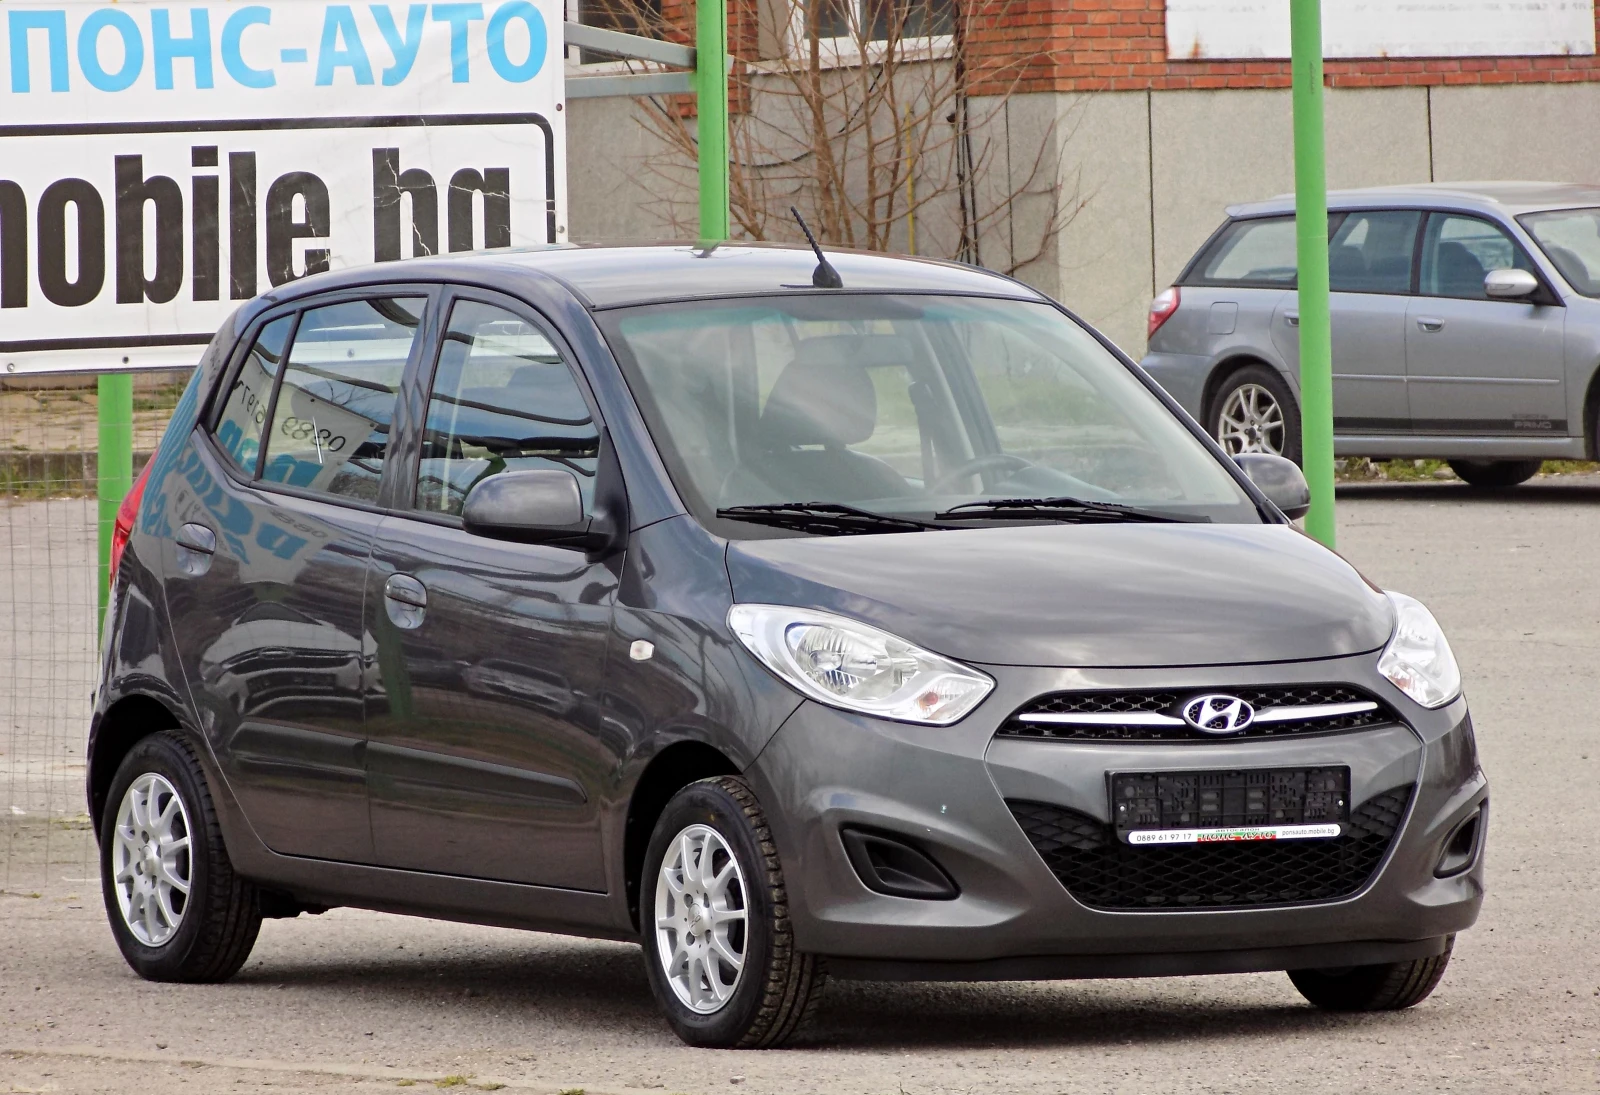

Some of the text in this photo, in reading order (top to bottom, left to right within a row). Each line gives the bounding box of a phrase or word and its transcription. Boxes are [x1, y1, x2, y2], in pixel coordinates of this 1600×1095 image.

[8, 0, 548, 93] ПОНС-АУТО
[0, 145, 331, 308] obile
[1170, 833, 1180, 841] 97
[1282, 828, 1335, 836] ponsauto.mobile.bg
